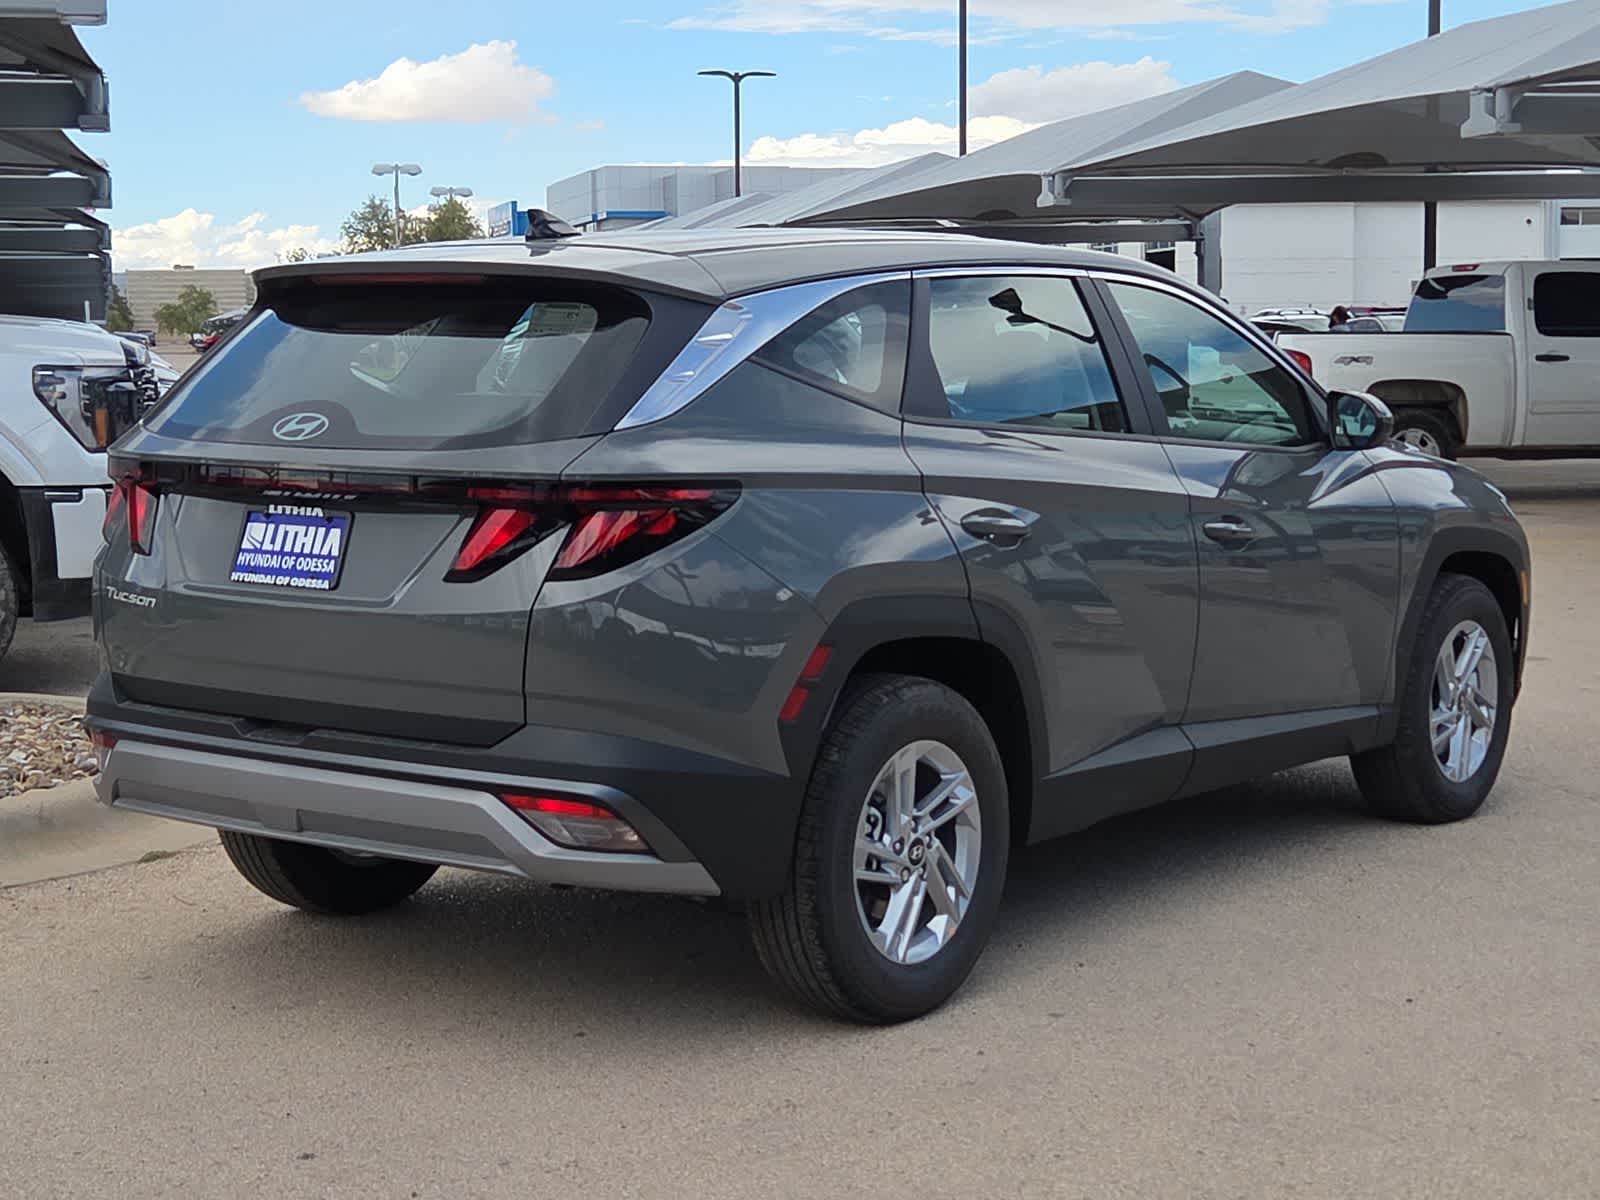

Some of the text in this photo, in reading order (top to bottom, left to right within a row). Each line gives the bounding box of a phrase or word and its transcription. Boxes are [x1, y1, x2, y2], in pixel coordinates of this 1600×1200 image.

[268, 504, 324, 517] LITHIA
[261, 523, 341, 556] LITHIA
[236, 552, 335, 573] HYUNDAI OF ODESSA
[231, 572, 330, 589] HYUNDAI OF ODESSA
